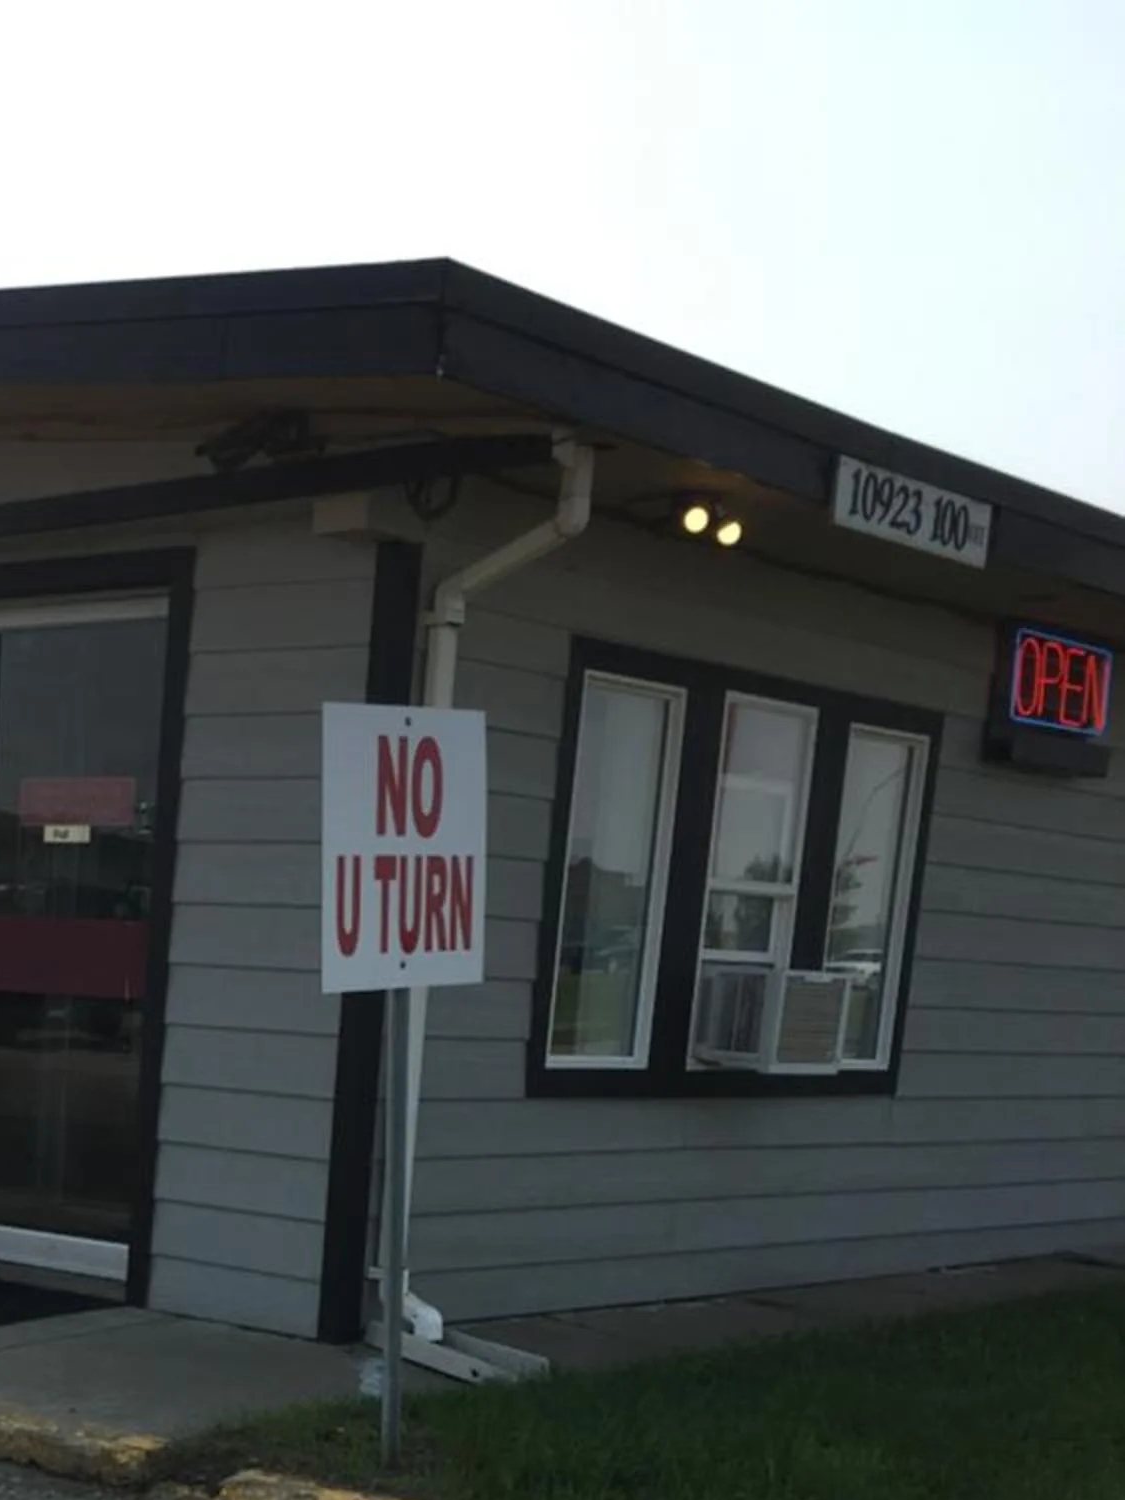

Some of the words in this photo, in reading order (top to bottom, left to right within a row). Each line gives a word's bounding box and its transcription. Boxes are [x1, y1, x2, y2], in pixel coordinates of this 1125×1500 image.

[848, 467, 923, 536] 10923
[929, 495, 970, 551] 100
[1017, 637, 1109, 732] OPEN
[376, 734, 443, 839] NO
[336, 855, 361, 957] U
[374, 855, 473, 955] TURN
